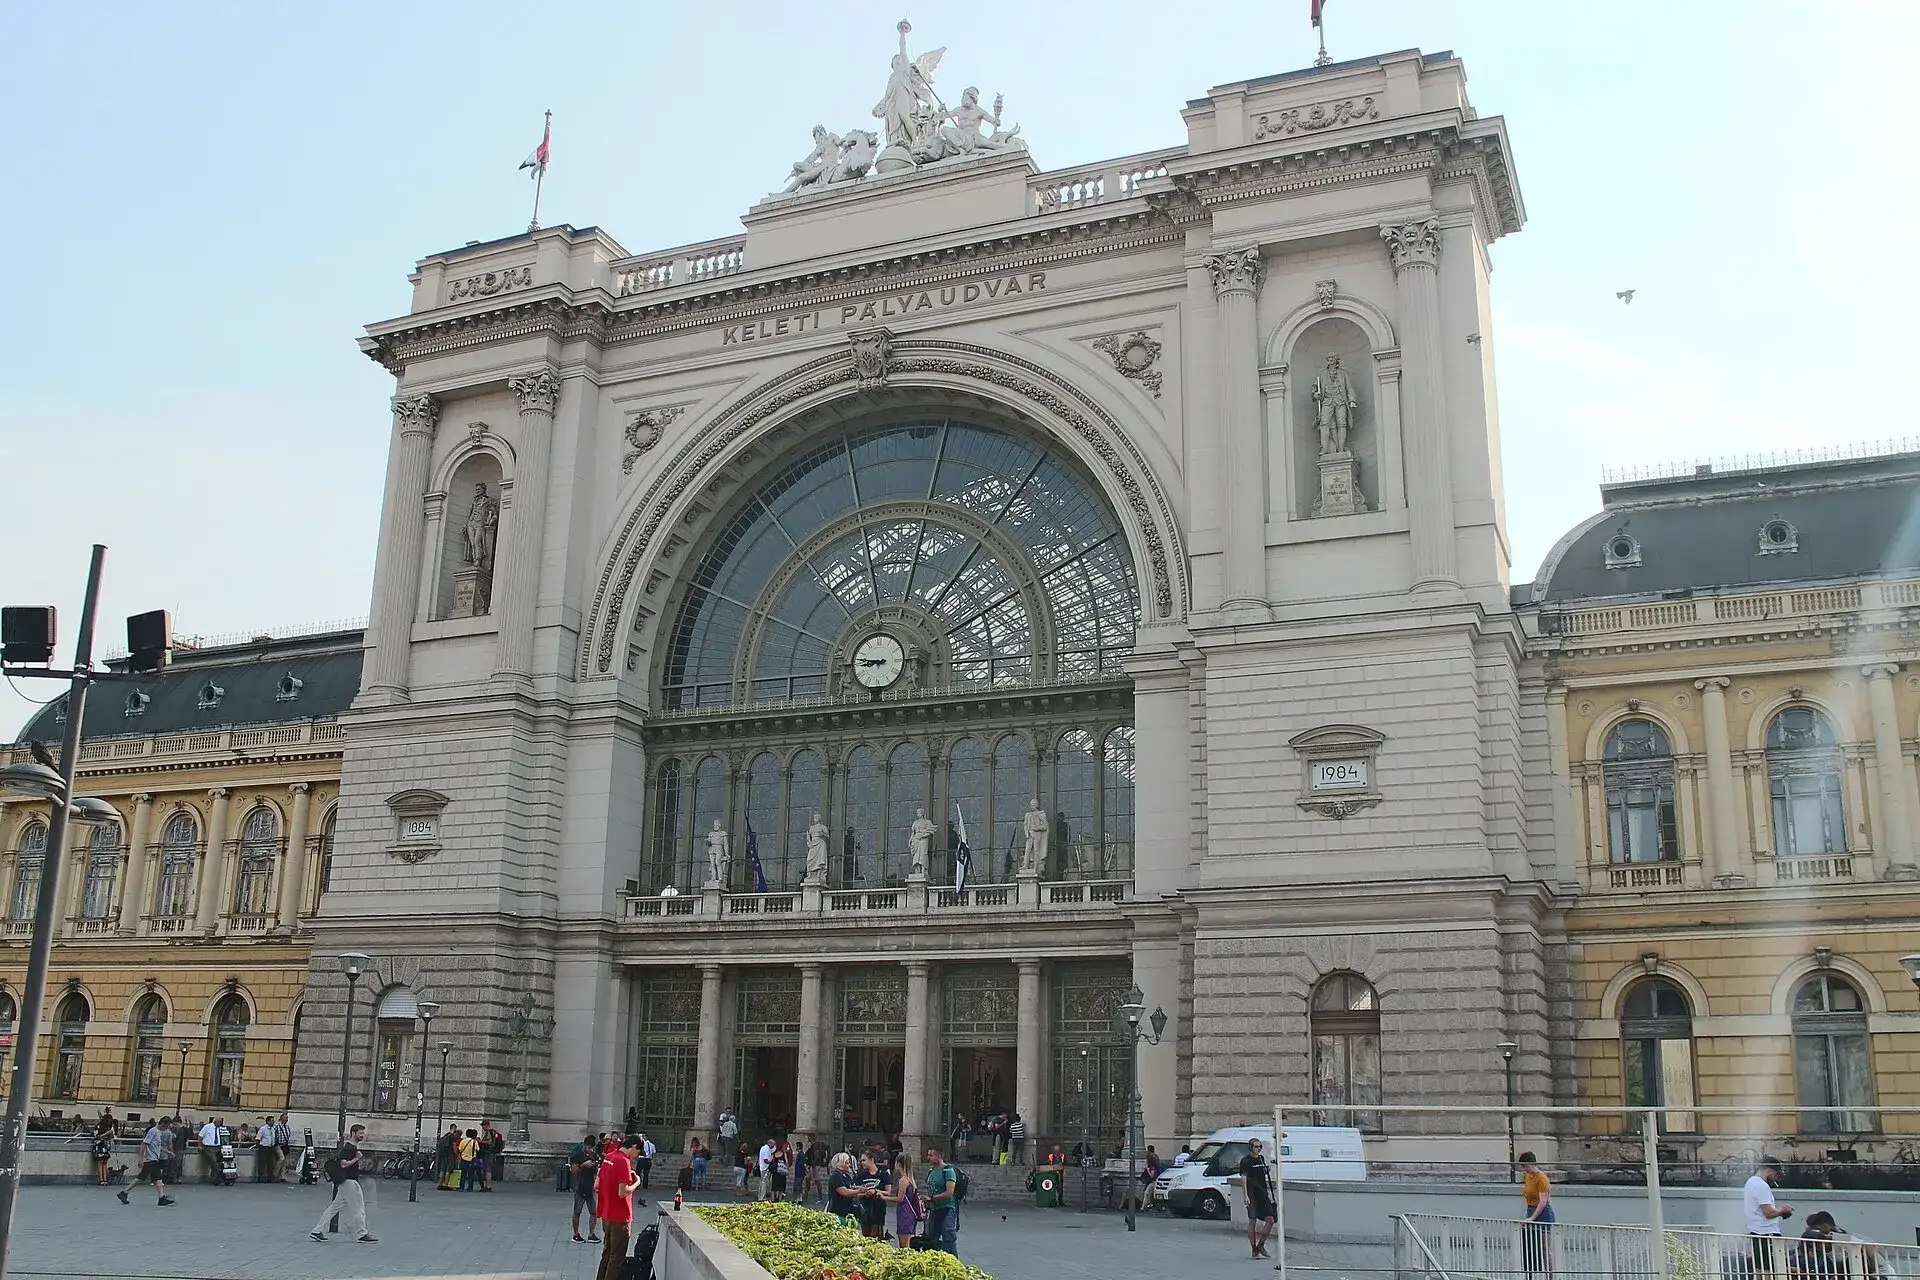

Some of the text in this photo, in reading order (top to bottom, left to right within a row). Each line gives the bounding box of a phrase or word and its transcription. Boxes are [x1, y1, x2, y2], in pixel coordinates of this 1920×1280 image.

[722, 271, 1047, 346] KELETI PÁLYAUDVAR
[1321, 765, 1358, 780] 1984
[408, 821, 431, 833] 1884
